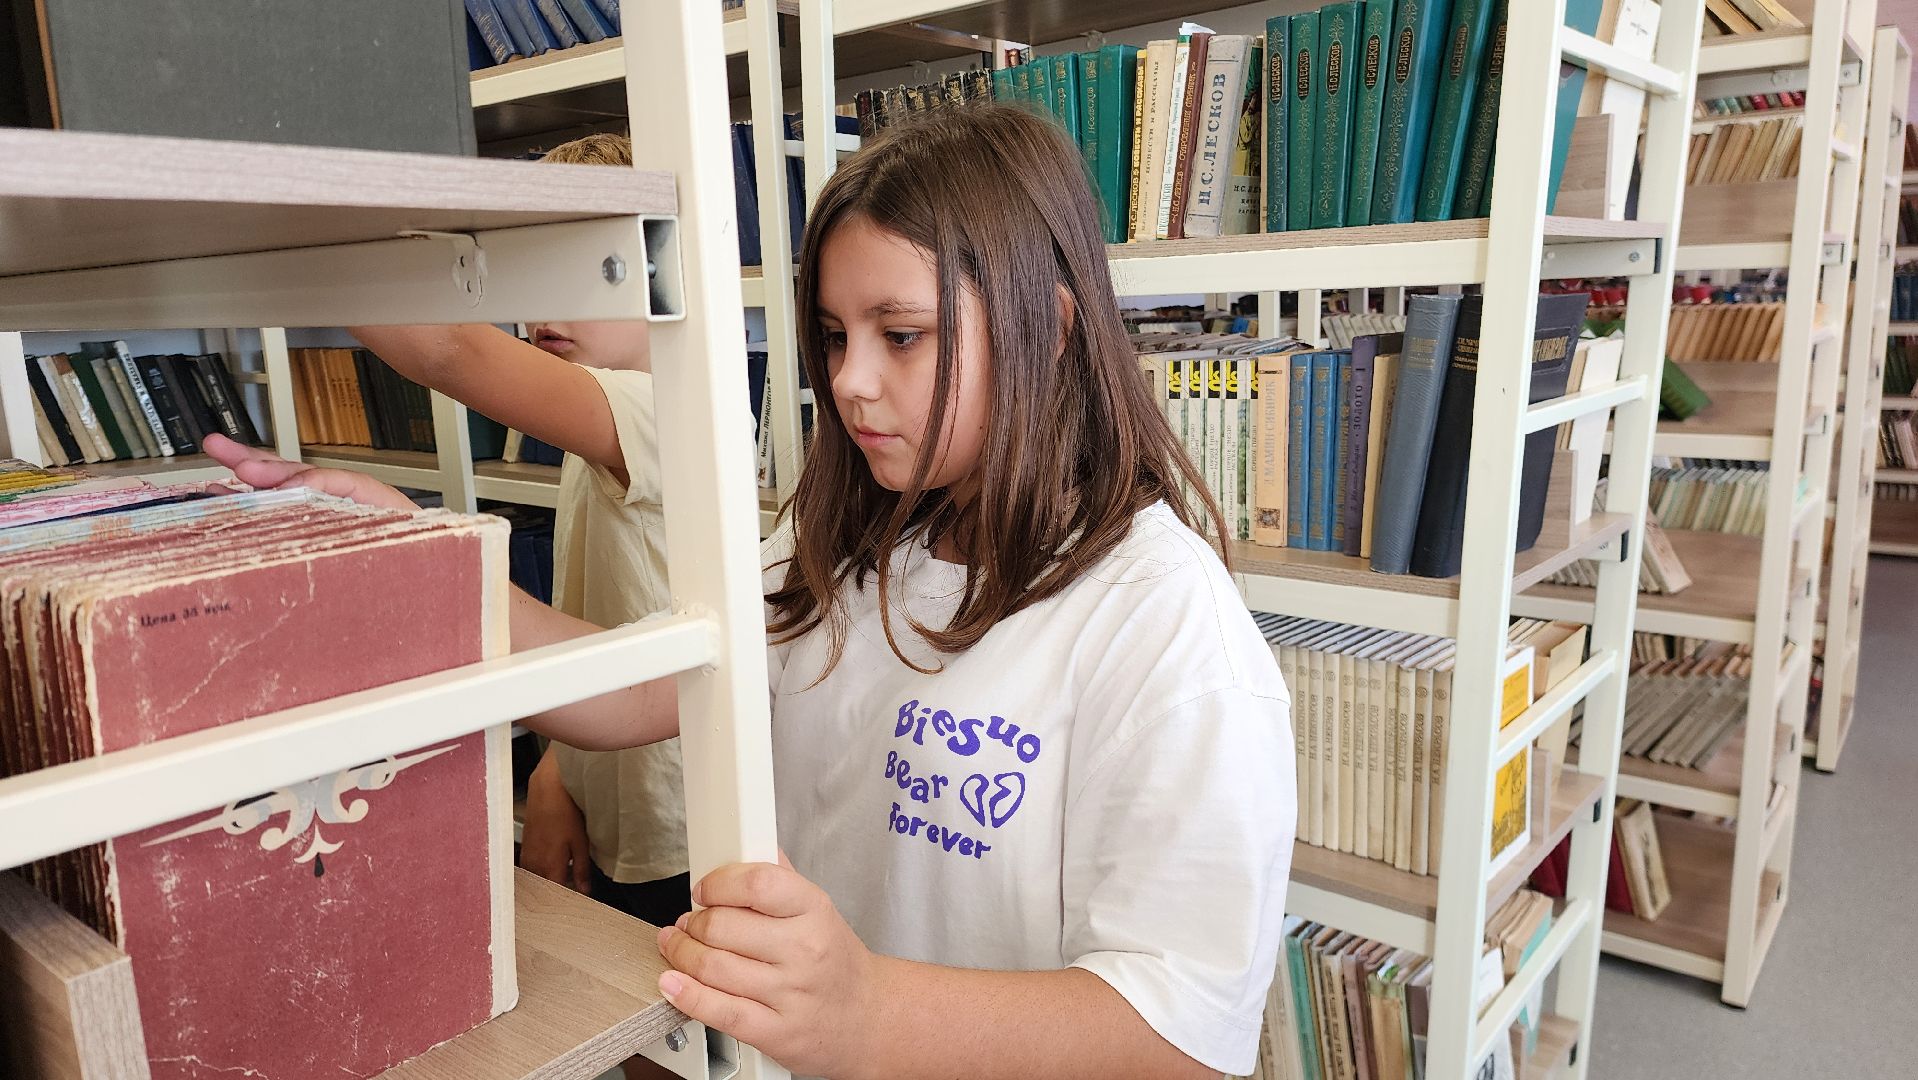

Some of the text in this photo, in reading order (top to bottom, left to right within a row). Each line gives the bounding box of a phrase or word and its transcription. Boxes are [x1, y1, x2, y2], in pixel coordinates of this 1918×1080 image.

[1197, 73, 1227, 205] Н.С.ЛЕСКОВ
[1353, 385, 1363, 430] ЗОЛОТО
[140, 613, 176, 627] Цена
[895, 700, 1040, 763] Biesuo
[885, 751, 948, 803] Bear
